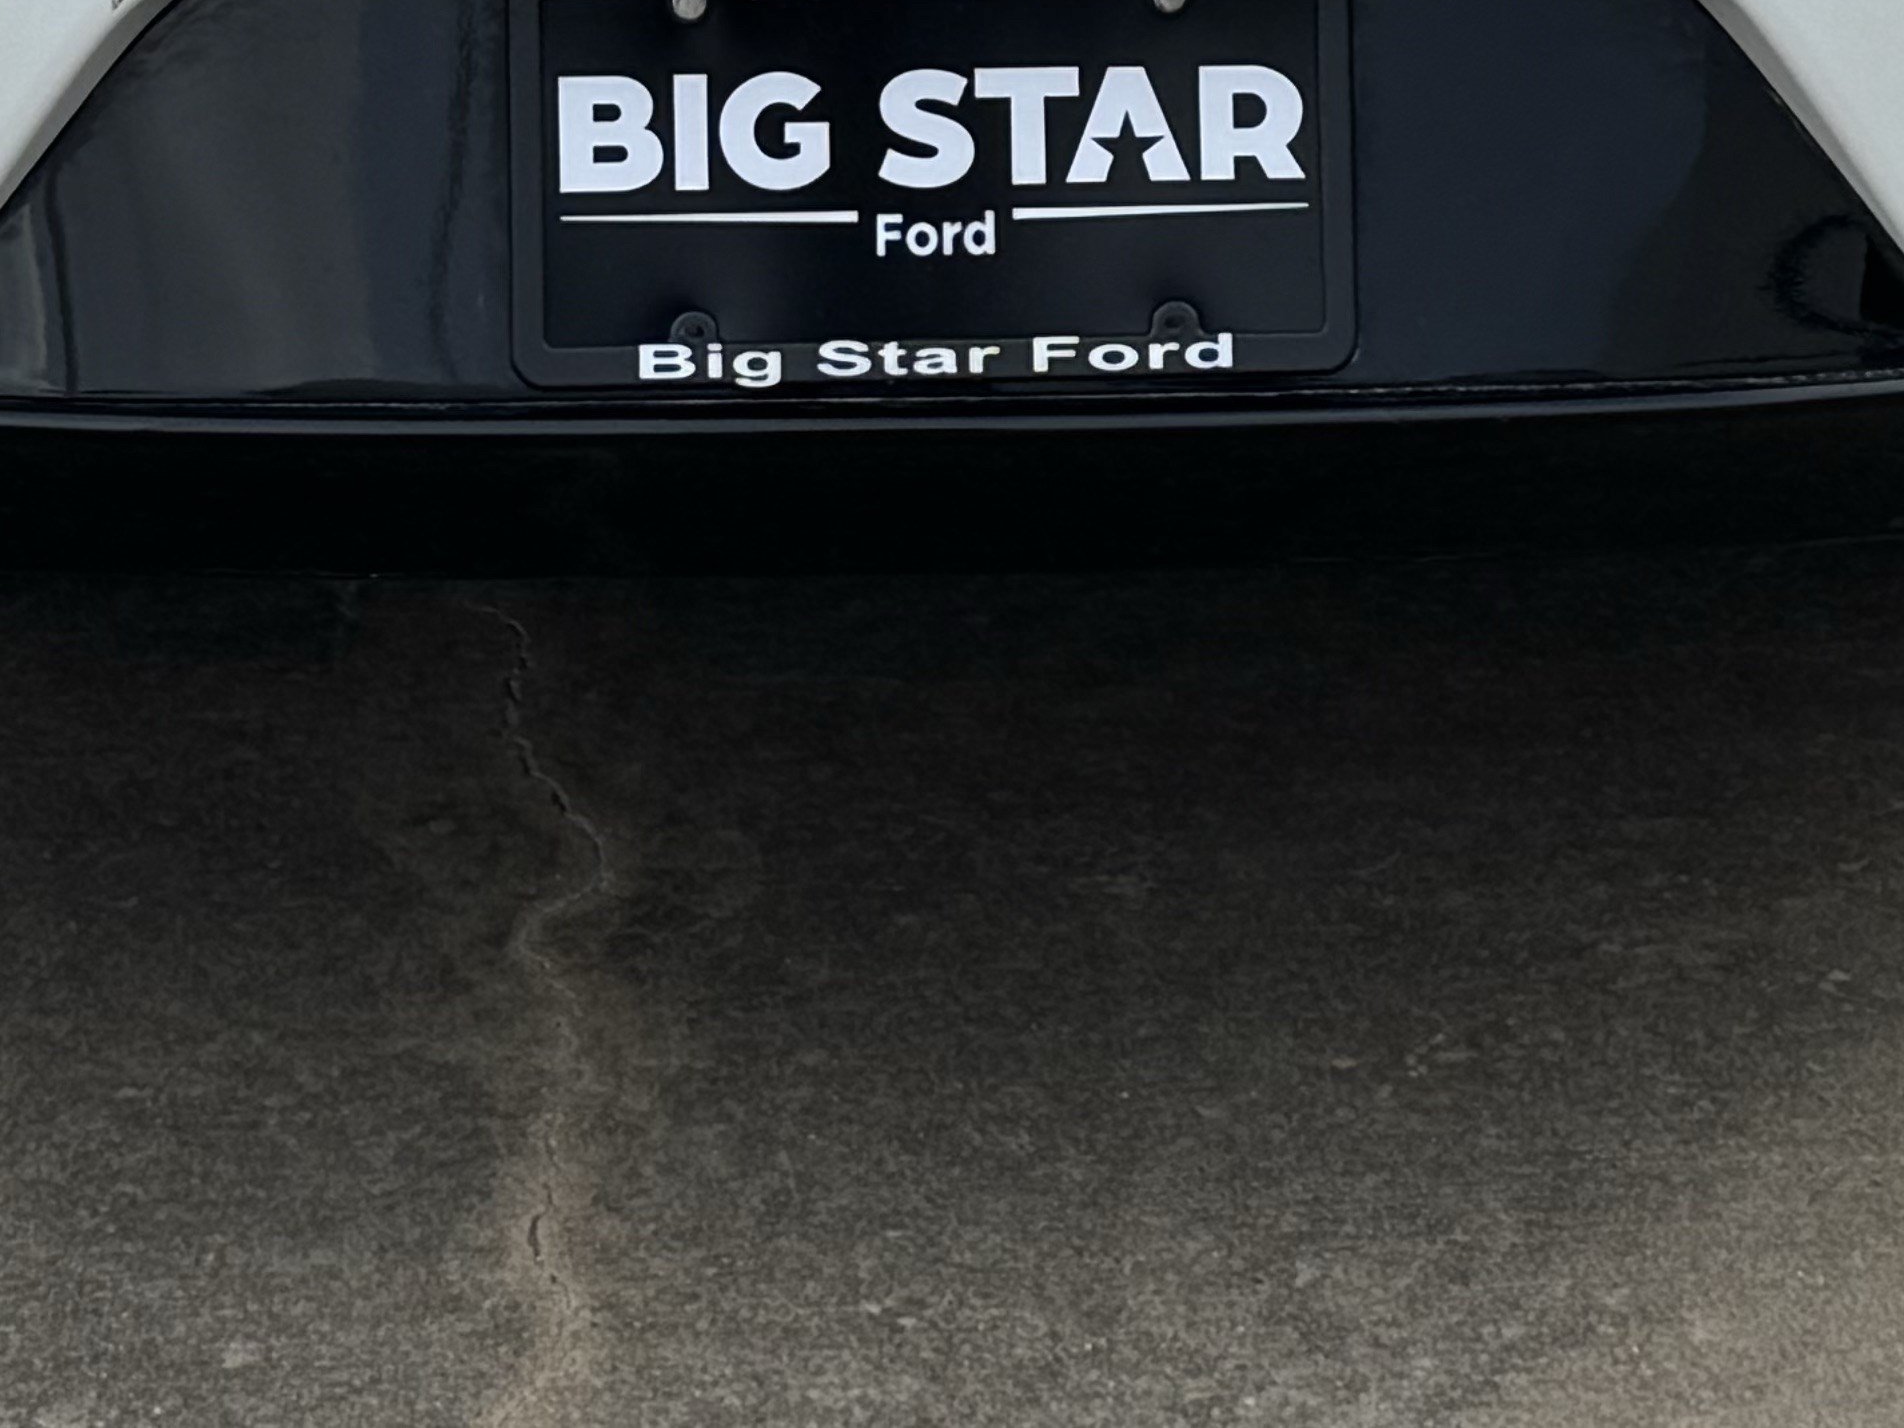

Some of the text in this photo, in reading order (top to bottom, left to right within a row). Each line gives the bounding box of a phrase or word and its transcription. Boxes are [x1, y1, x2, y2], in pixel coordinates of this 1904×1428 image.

[557, 64, 1306, 194] BIG STAR
[875, 209, 997, 257] Ford
[637, 331, 1234, 388] Big Star Ford
